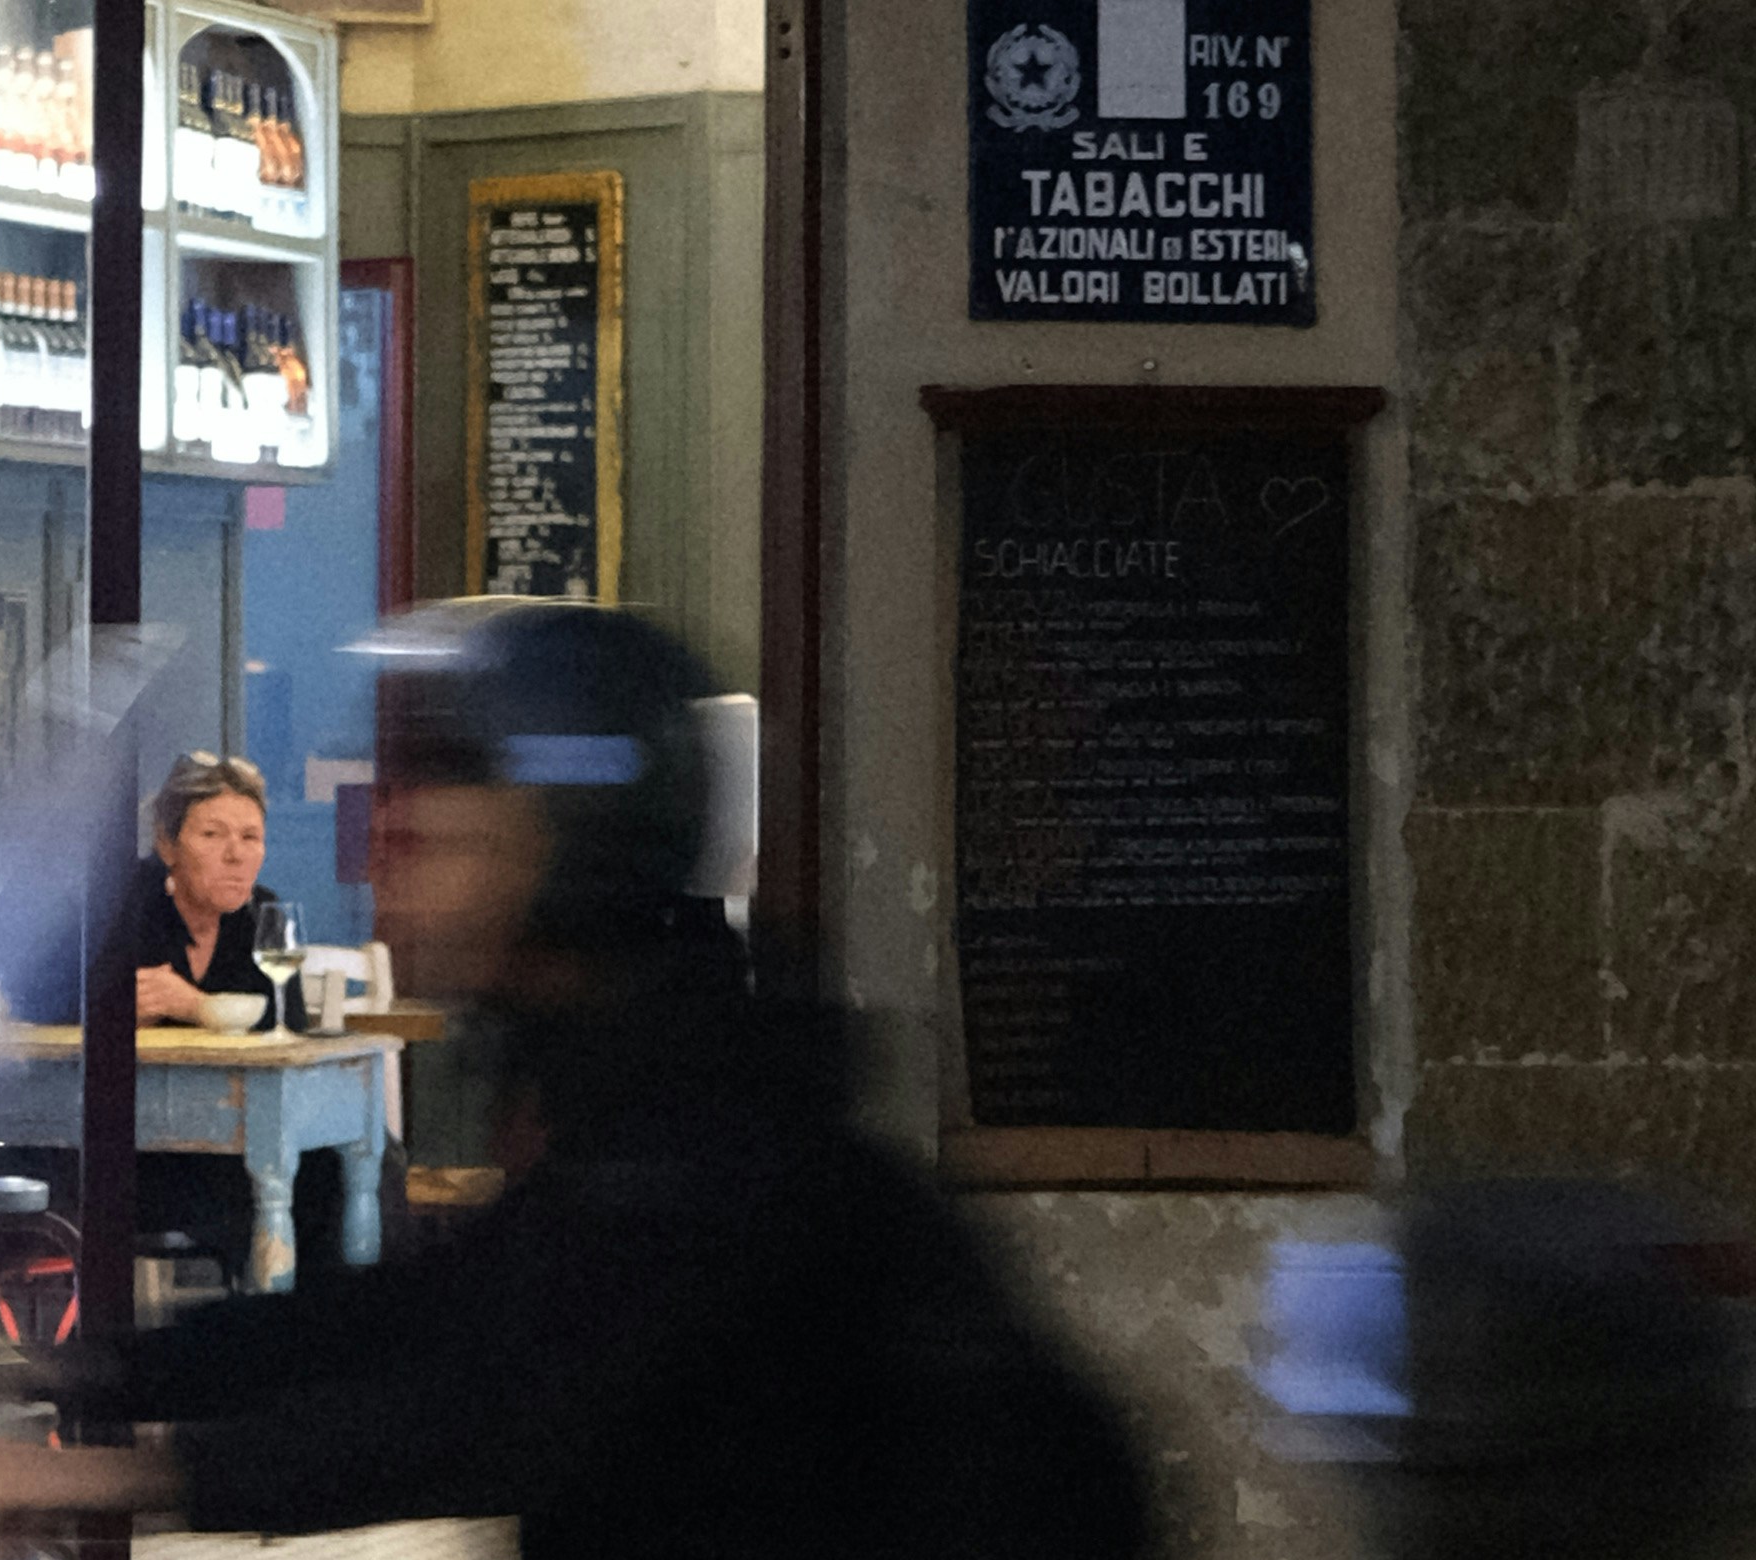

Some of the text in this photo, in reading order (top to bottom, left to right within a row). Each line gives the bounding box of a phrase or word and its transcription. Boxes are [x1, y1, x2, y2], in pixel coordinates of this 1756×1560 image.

[1189, 33, 1247, 68] RIV.
[1203, 81, 1282, 120] 169
[1072, 132, 1209, 161] SALI E
[1020, 169, 1265, 219] TABACCHI
[1190, 228, 1289, 262] ESTERI
[996, 269, 1288, 305] VALORI BOLLATI
[974, 538, 1182, 579] SCHIACCIATE
